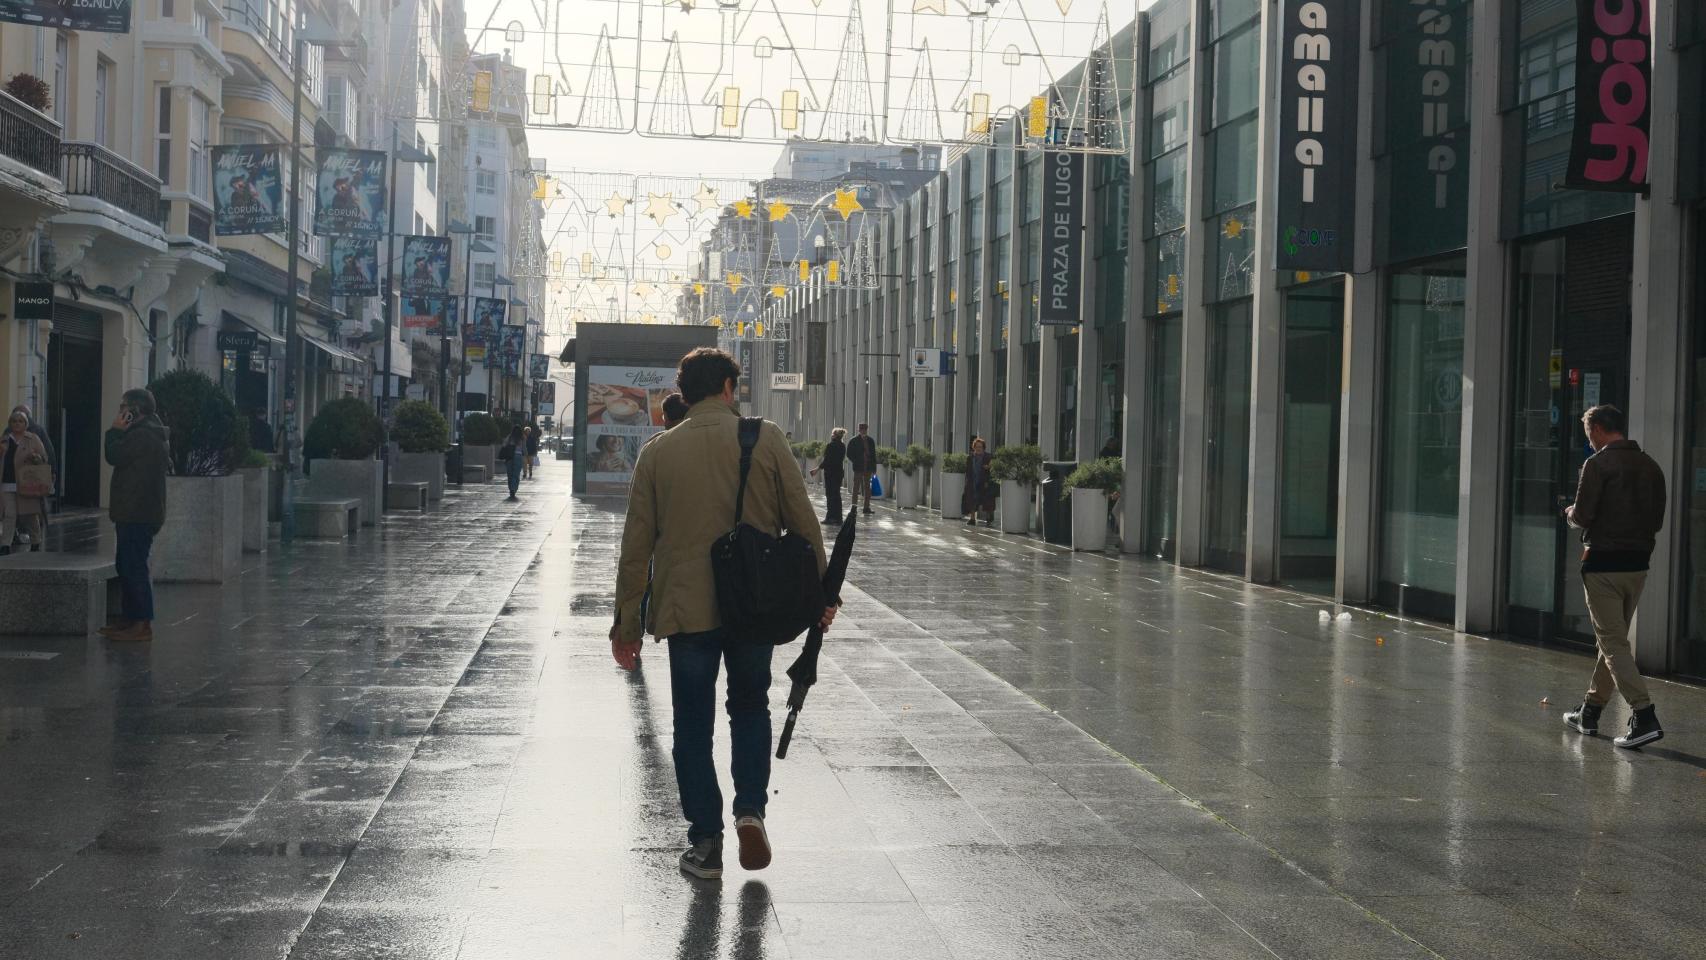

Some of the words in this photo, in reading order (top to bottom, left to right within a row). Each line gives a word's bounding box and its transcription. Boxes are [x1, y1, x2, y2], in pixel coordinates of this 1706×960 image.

[1055, 152, 1072, 206] LUGO
[1054, 212, 1070, 239] DE
[1052, 244, 1070, 310] PRAZA
